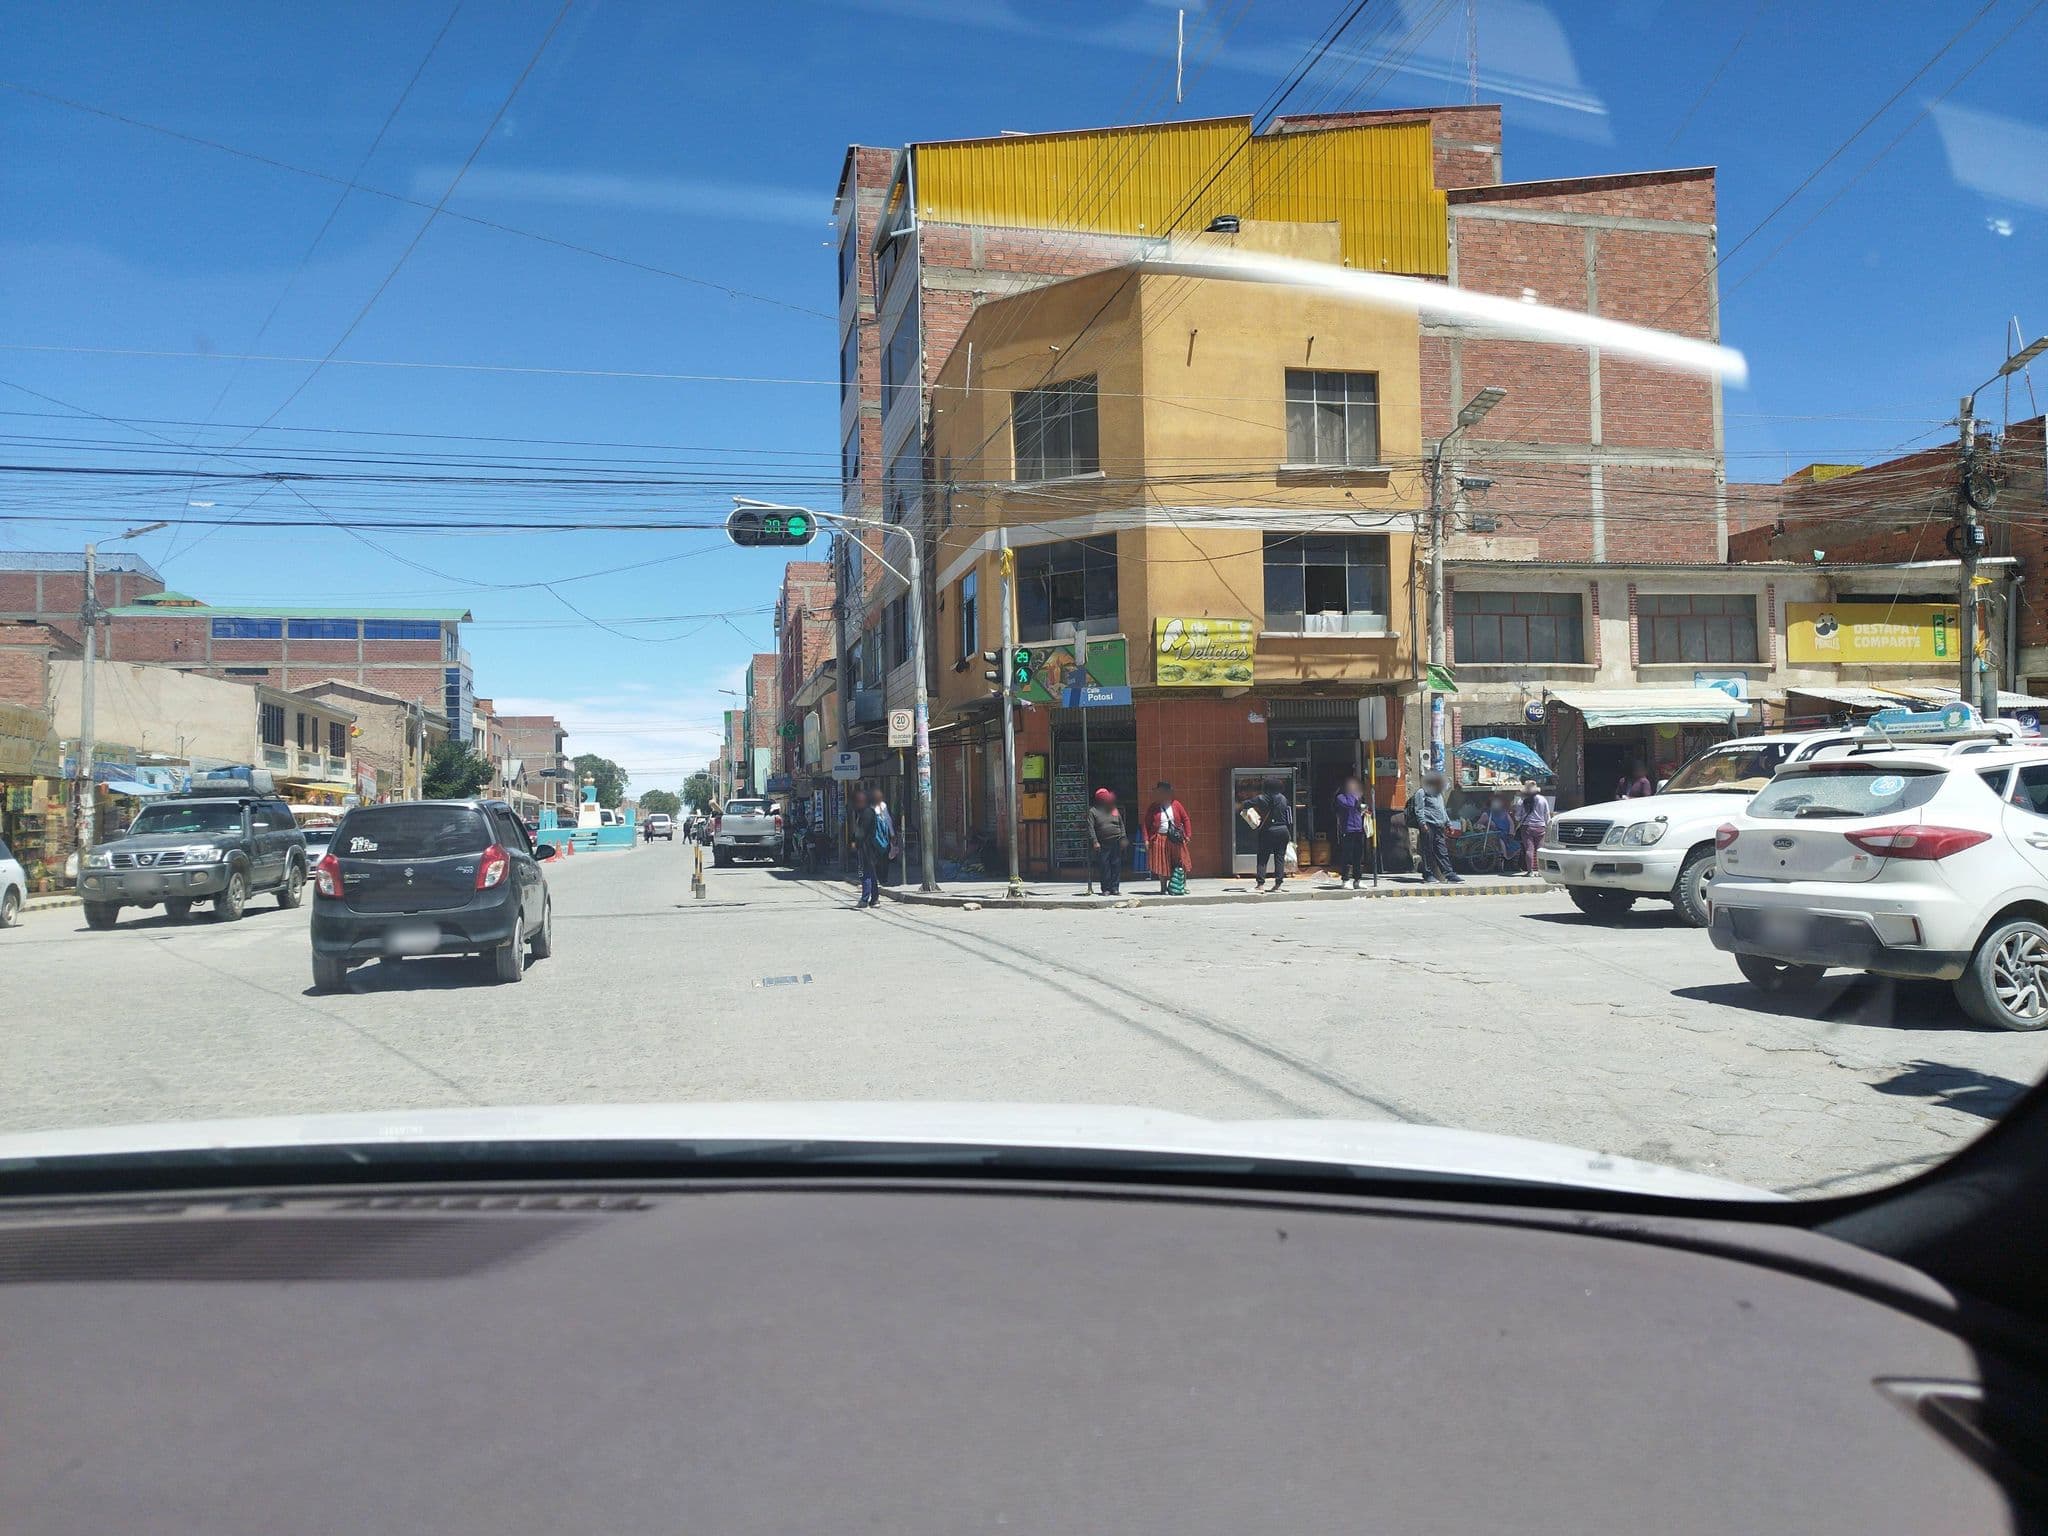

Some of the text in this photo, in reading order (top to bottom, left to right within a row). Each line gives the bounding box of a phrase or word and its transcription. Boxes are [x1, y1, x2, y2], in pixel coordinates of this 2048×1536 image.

[1854, 624, 1920, 635] DESTAPA Y
[1854, 636, 1921, 648] COMPARTE
[1175, 638, 1250, 660] Delicias
[896, 716, 906, 724] 20
[840, 754, 851, 764] P
